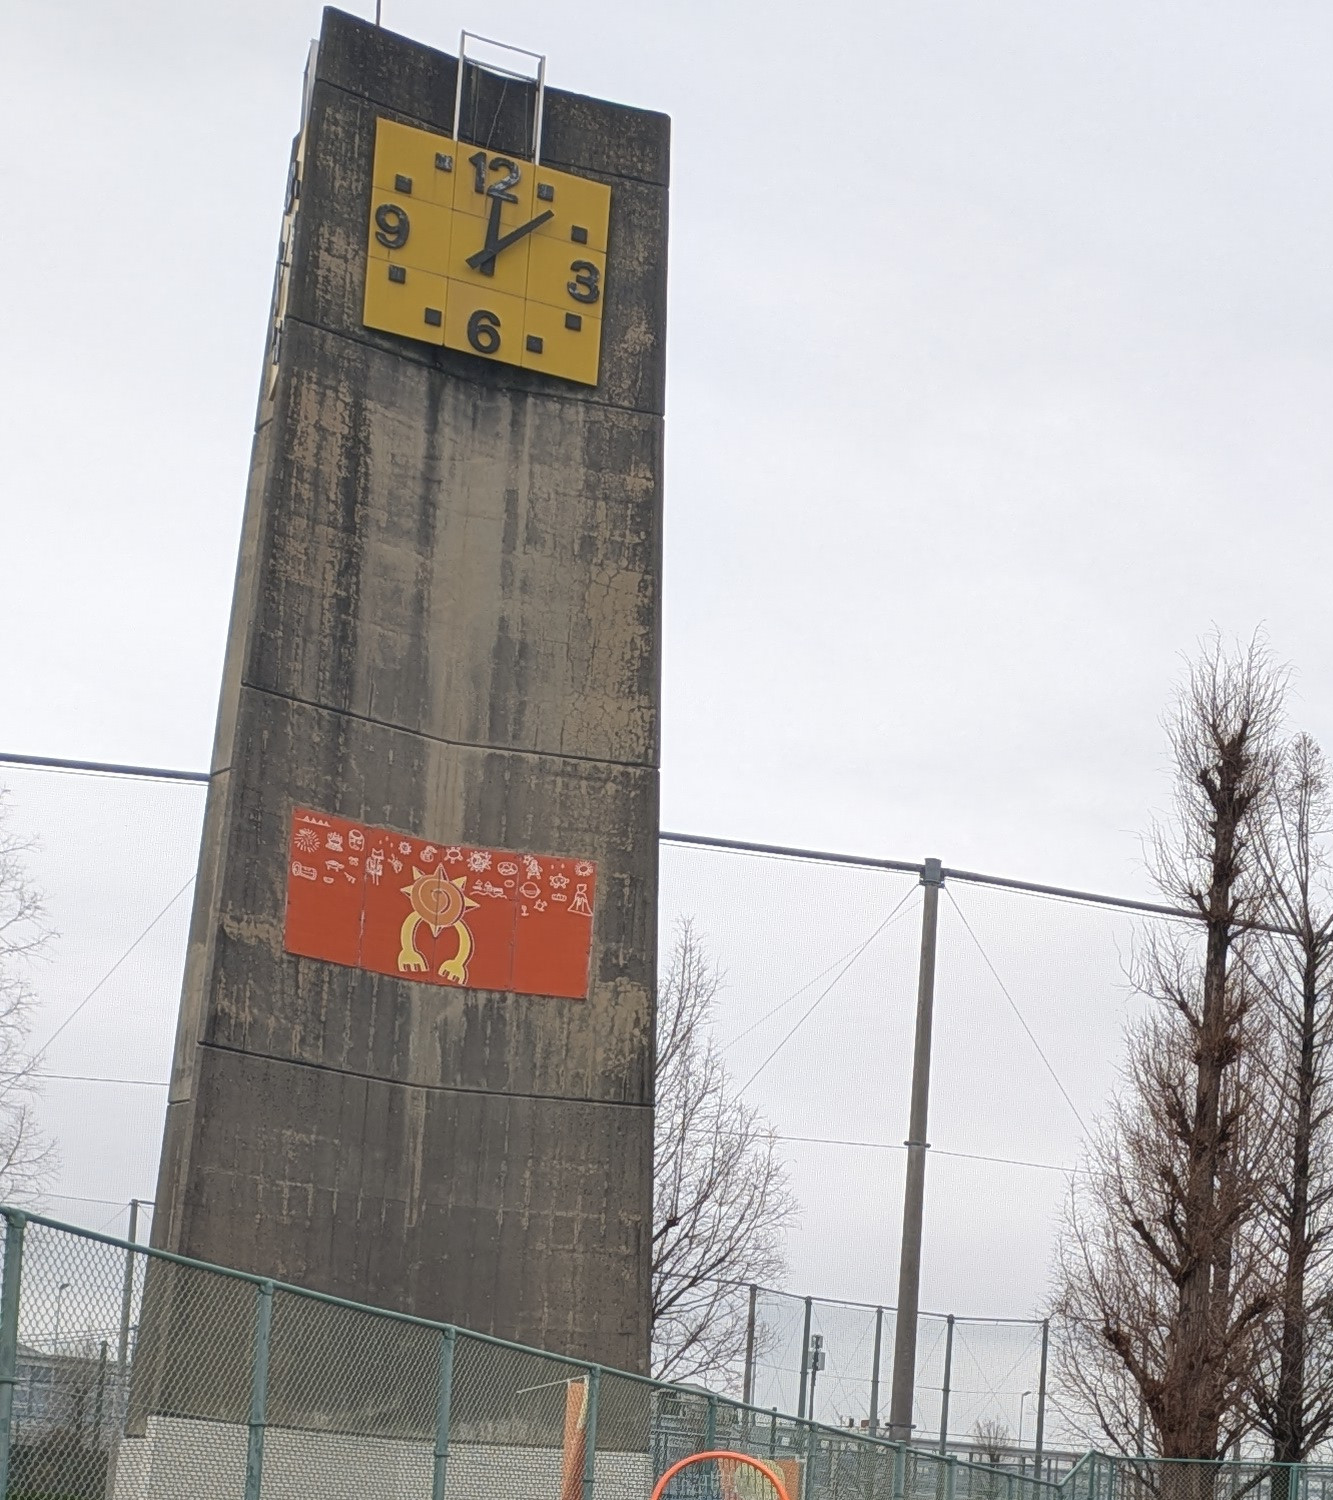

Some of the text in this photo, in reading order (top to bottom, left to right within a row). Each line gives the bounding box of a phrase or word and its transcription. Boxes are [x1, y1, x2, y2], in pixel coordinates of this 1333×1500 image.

[468, 151, 522, 205] 12
[374, 203, 411, 249] 9
[567, 260, 600, 304] 3
[467, 309, 502, 354] 6
